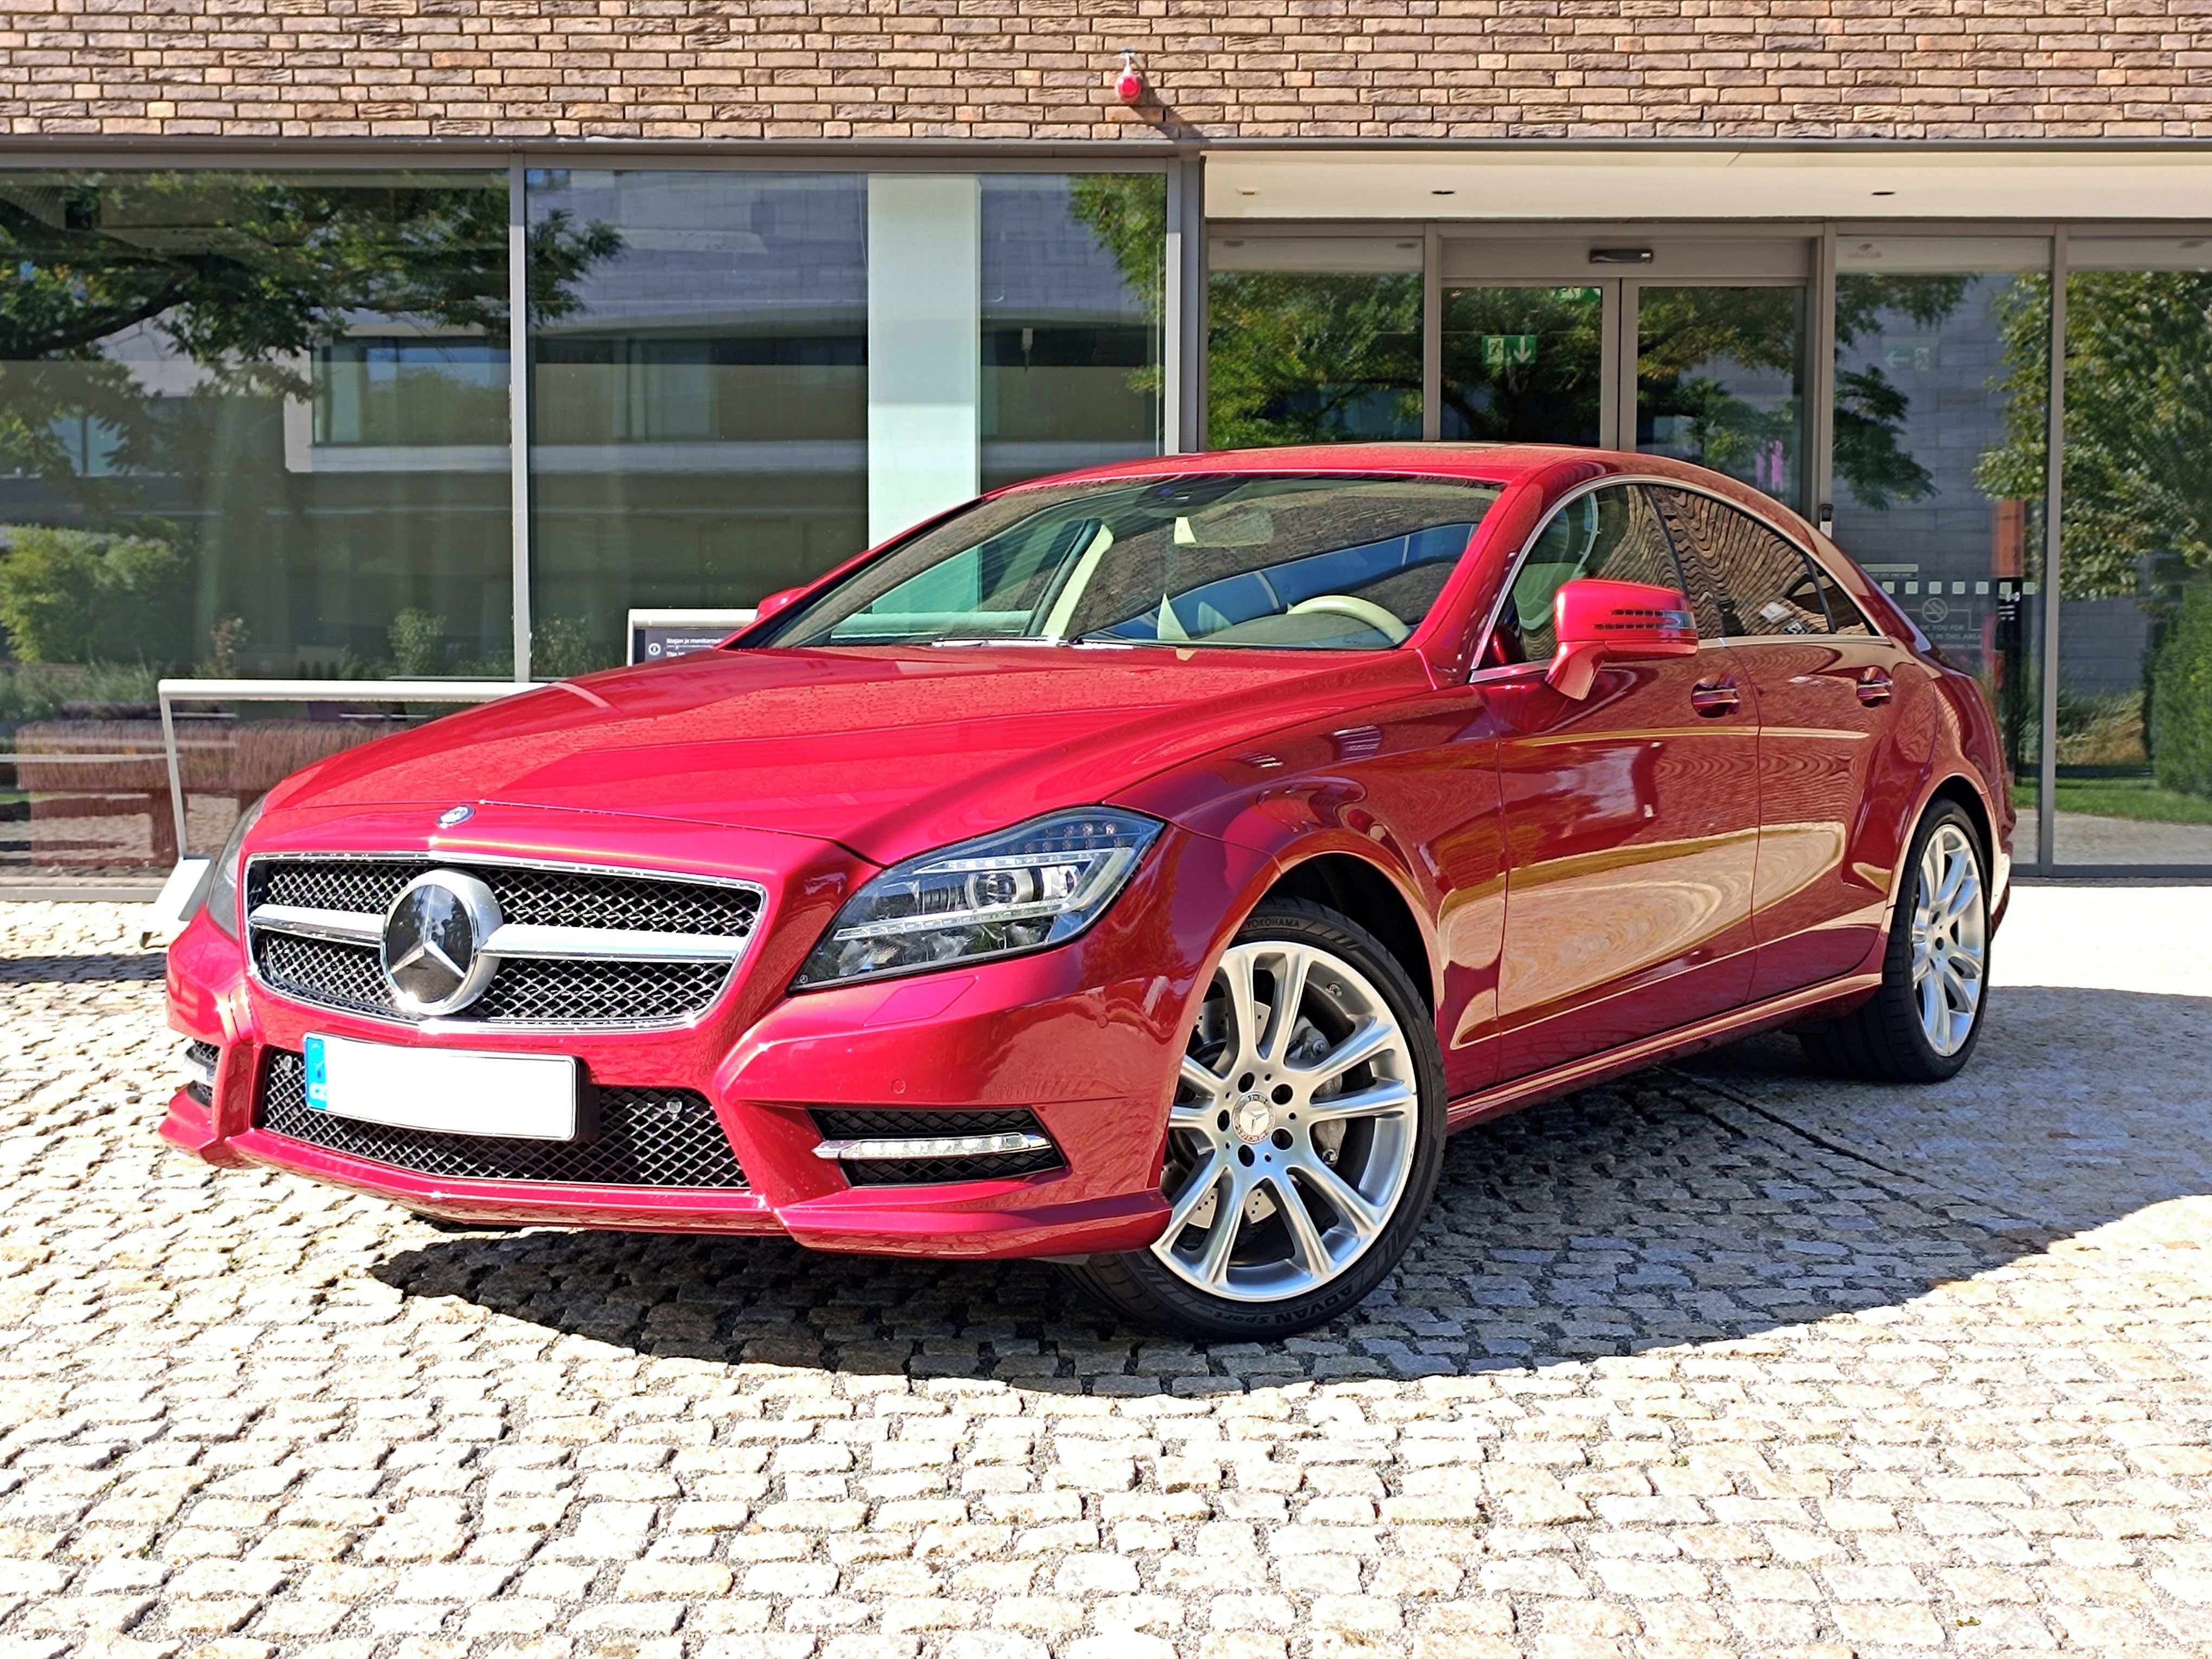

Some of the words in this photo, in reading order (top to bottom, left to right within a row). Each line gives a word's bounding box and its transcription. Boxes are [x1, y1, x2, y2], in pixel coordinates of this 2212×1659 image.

[1247, 918, 1300, 928] YOKOHAMA
[1276, 1283, 1353, 1324] ADVAN
[1215, 1310, 1270, 1324] Sport
